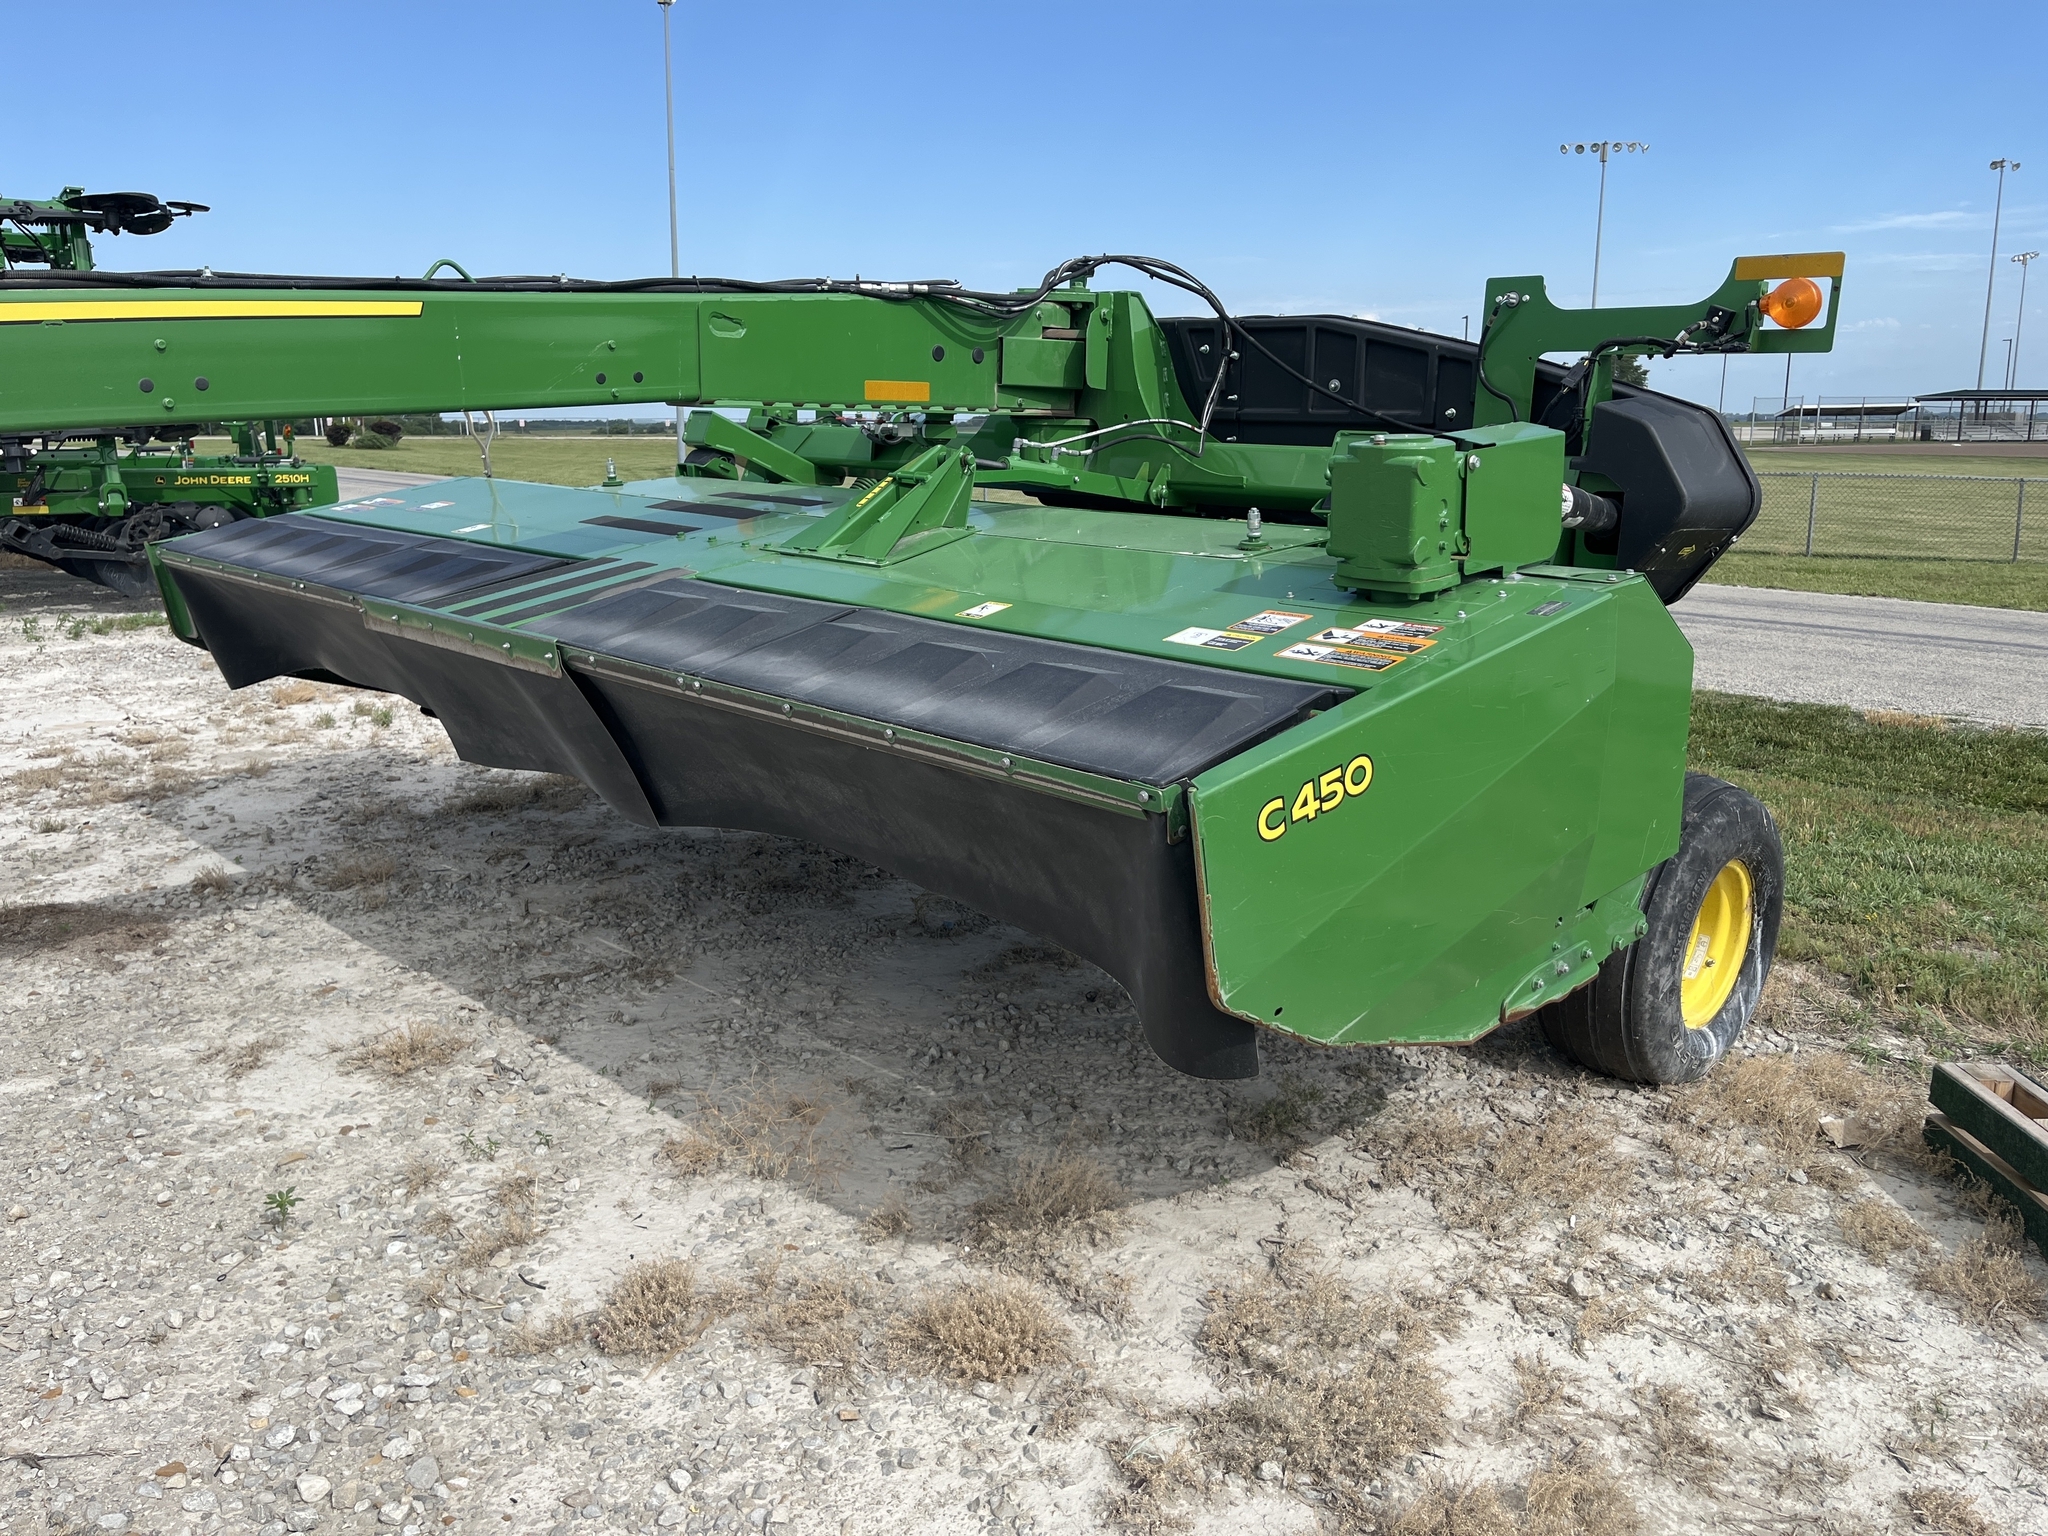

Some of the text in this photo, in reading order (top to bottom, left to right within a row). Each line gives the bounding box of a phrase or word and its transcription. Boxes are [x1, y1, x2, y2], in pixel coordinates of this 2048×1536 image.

[174, 474, 310, 485] JOHN DEERE 2510H
